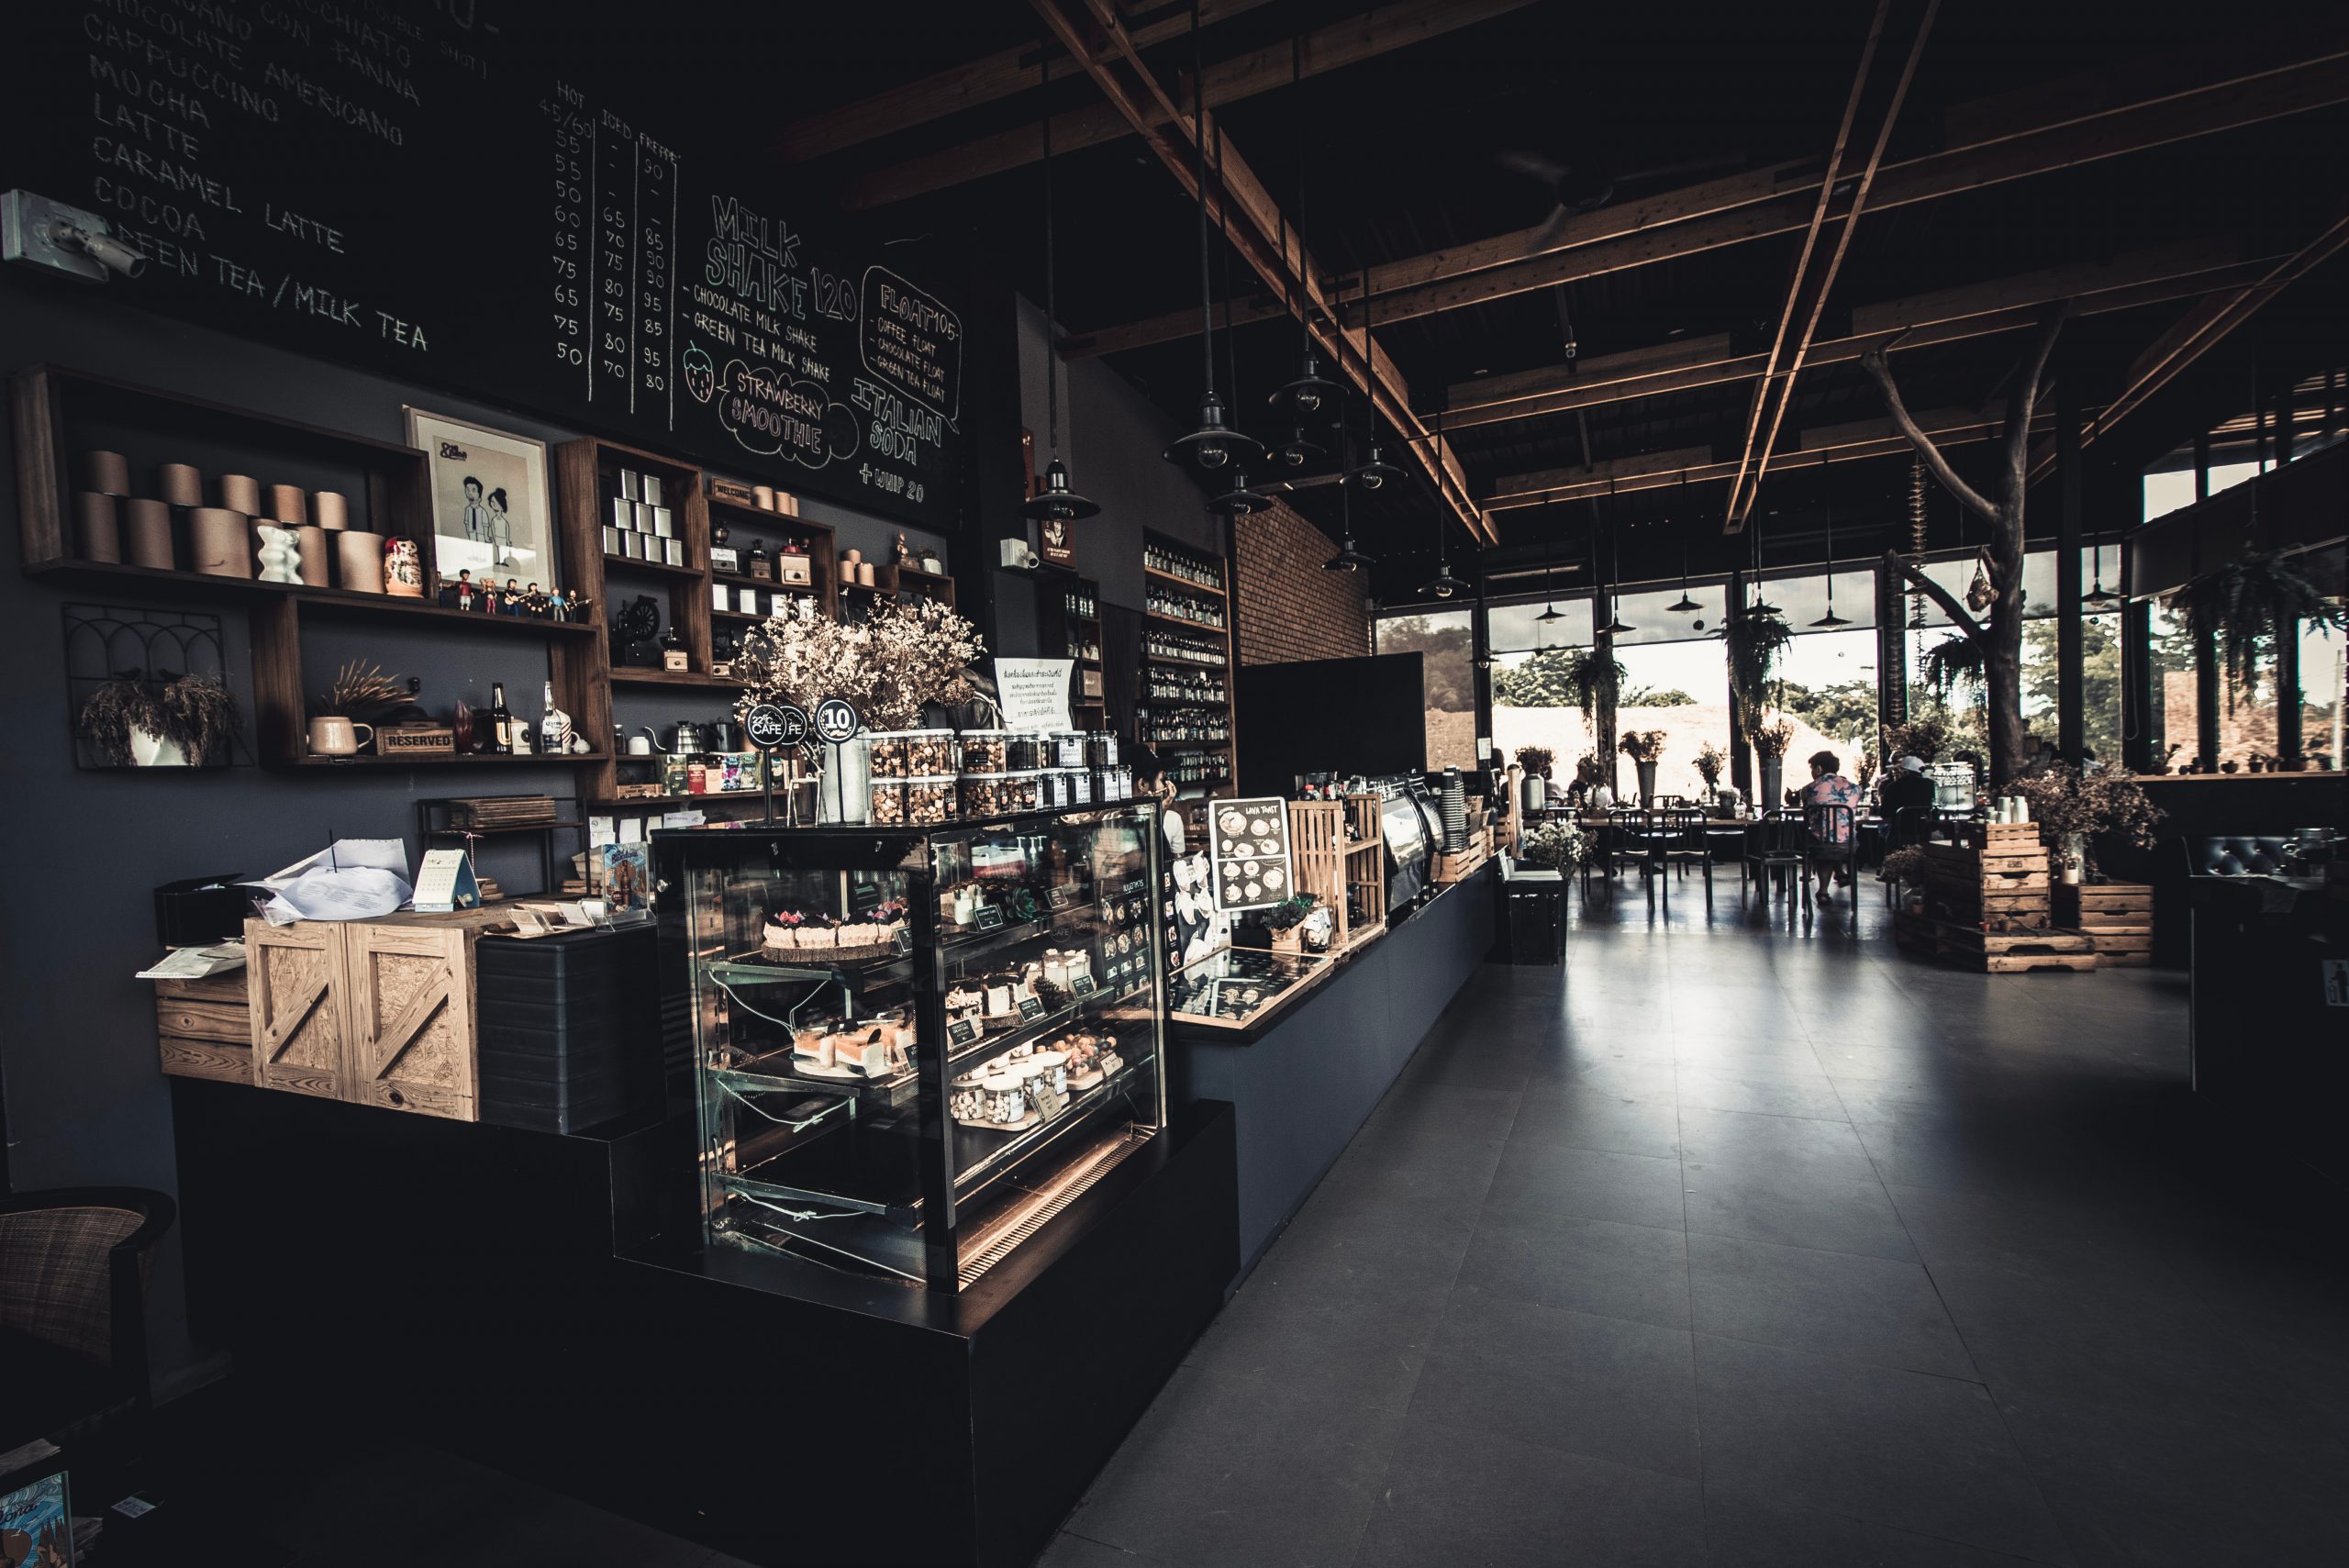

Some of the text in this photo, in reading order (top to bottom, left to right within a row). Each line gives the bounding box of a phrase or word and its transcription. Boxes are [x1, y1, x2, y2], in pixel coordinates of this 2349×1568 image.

[83, 13, 279, 122] CAPPUCCINO
[330, 39, 421, 107] PANNA
[89, 53, 211, 129] MOCHA
[557, 79, 585, 109] HOT
[263, 61, 404, 146] AMERICANO
[93, 92, 199, 161] LATTE
[538, 97, 593, 139] 45/60
[601, 108, 632, 139] ICED
[556, 128, 581, 154] 55
[555, 153, 582, 181] 55
[93, 137, 346, 254] CARAMEL LATTE
[555, 180, 582, 203] 50
[93, 176, 206, 240] COCOA
[554, 205, 581, 228] 60
[603, 206, 625, 228] 65
[554, 231, 577, 250] 65
[606, 229, 625, 248] 70
[645, 228, 663, 250] 85
[712, 195, 801, 268] MILK
[552, 255, 576, 279] 75
[605, 250, 623, 271] 75
[646, 250, 664, 270] 90
[117, 223, 199, 276] EEN
[375, 309, 429, 352] TEA
[605, 278, 624, 297] 80
[646, 270, 664, 288] 90
[706, 238, 858, 321] SHAKE 120
[554, 284, 578, 306] 65
[644, 292, 662, 312] 95
[604, 301, 624, 321] 75
[694, 284, 817, 354] CHOCOLATE MILK SHAKE
[881, 284, 934, 331] FLOAT
[553, 314, 578, 336] 75
[644, 318, 662, 336] 85
[604, 332, 625, 353] 80
[694, 311, 830, 383] GREEN TEA MILK SHAKE
[877, 317, 936, 357] COFFEE FLOAT
[557, 342, 583, 365] 50
[644, 347, 661, 367] 95
[877, 338, 945, 383] CHOCOLATE FLOAT
[604, 359, 625, 378] 70
[646, 374, 664, 391] 80
[923, 381, 946, 404] FLOAT
[737, 372, 823, 420] STRAWBERRY
[851, 377, 941, 448] ITALIAN
[731, 397, 822, 454] SMOOTHIE
[869, 420, 917, 466] SODA
[716, 484, 750, 501] WELCOME
[874, 468, 905, 495] WHIP
[907, 480, 924, 503] 20
[752, 724, 782, 735] CAFE
[788, 725, 803, 735] FE
[825, 708, 851, 729] 10
[388, 736, 451, 747] RESERVED
[1261, 805, 1278, 815] TOAST
